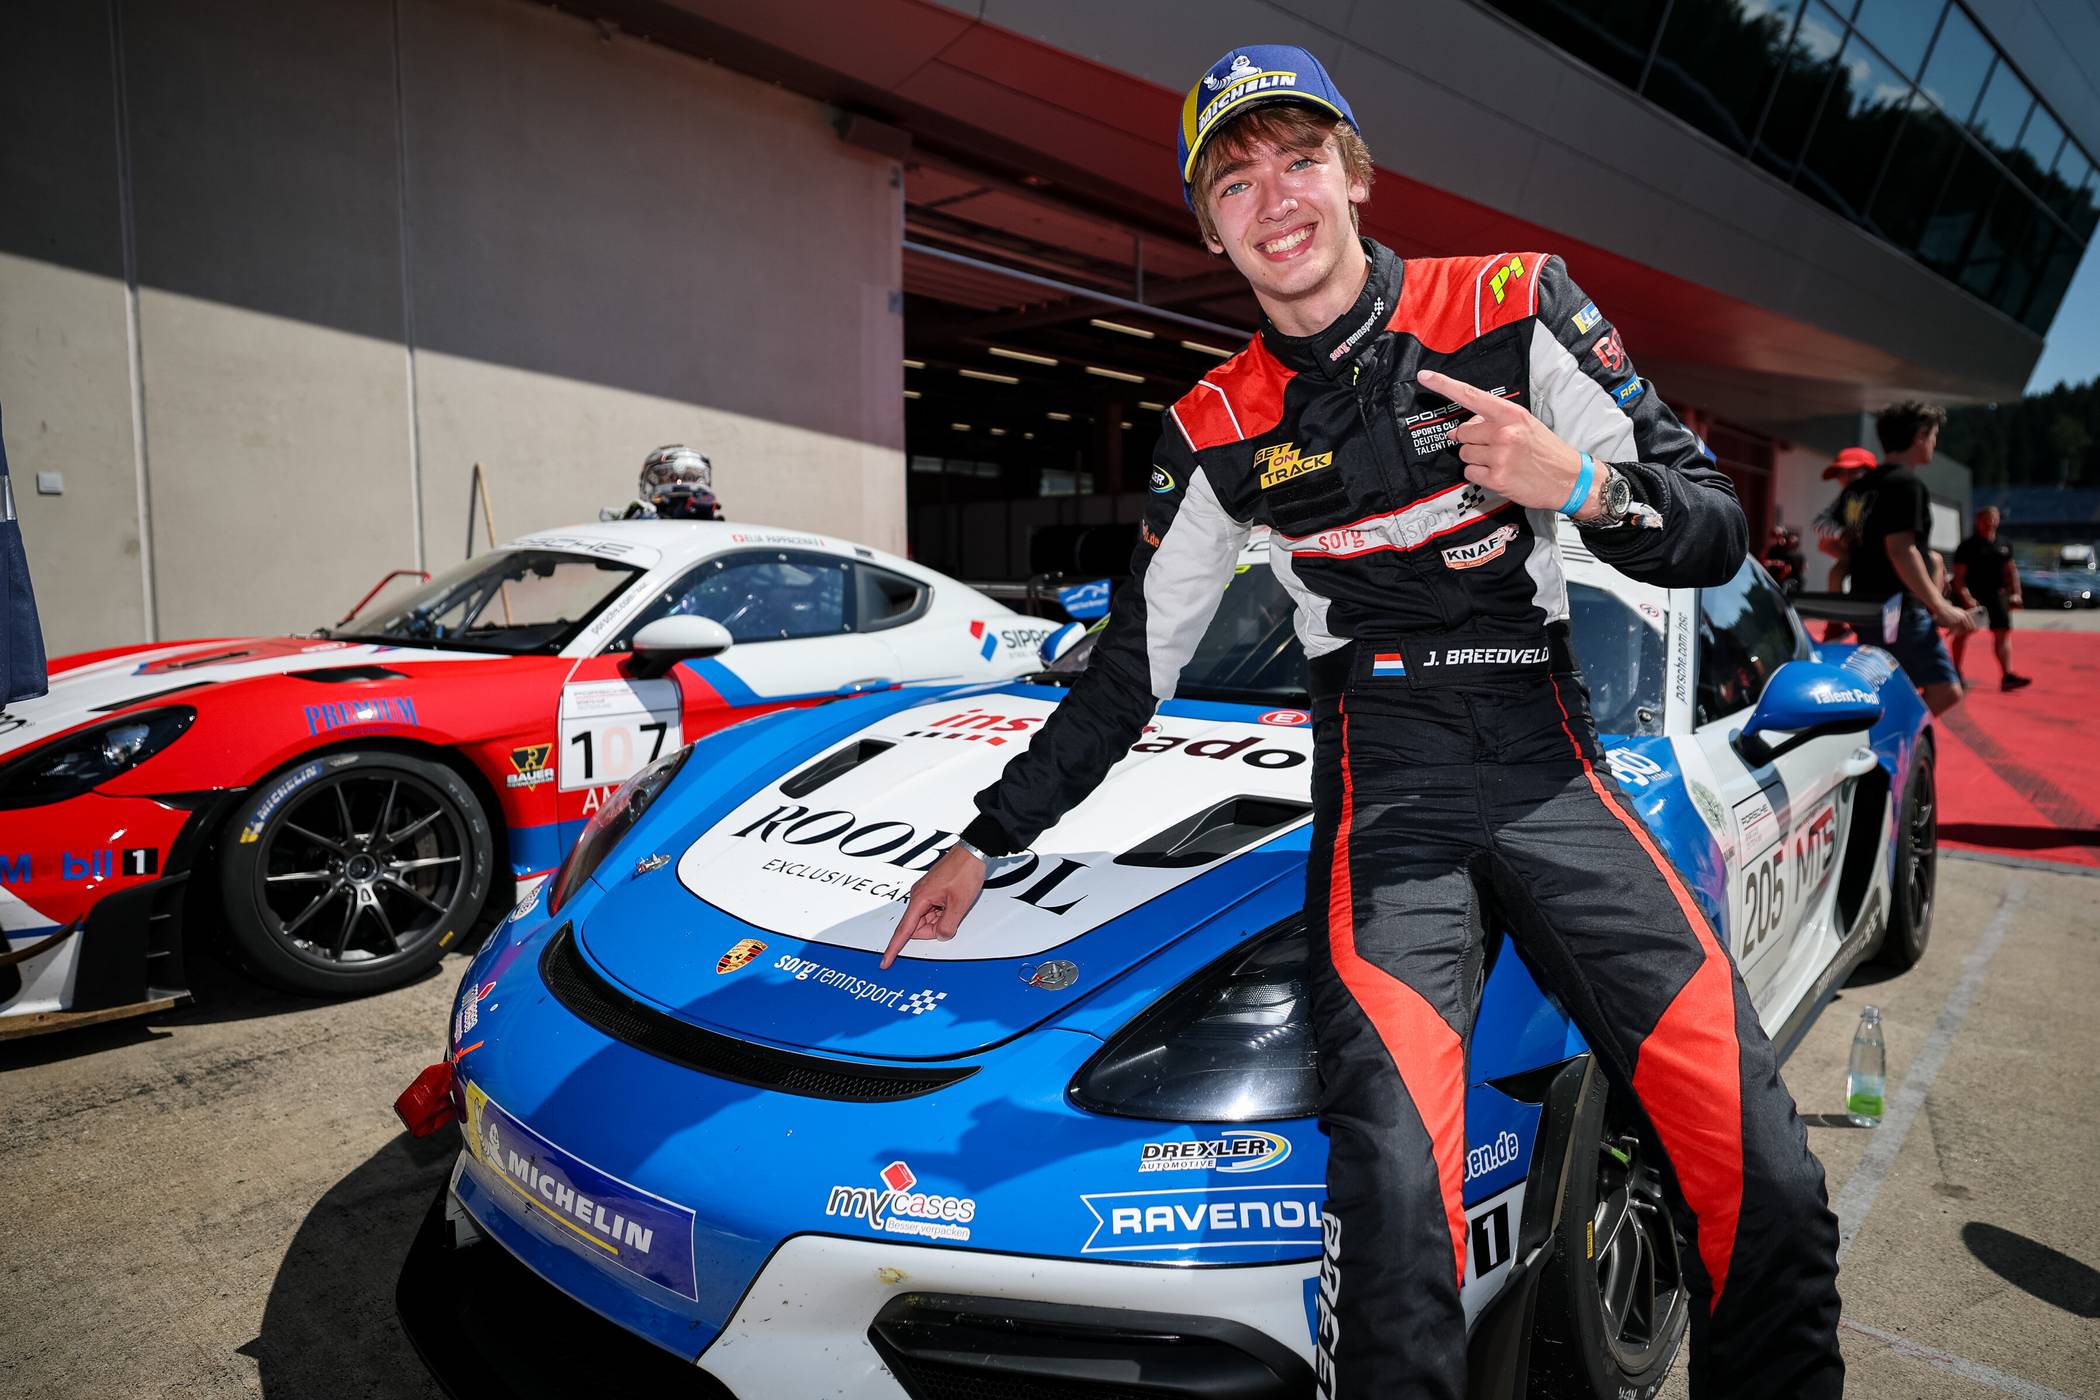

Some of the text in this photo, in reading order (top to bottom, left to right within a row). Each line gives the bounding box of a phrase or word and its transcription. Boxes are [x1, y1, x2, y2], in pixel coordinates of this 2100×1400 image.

[1199, 75, 1297, 132] MICHELIN
[1490, 255, 1526, 305] P1
[1411, 418, 1460, 439] SPORTS CUP
[1413, 432, 1449, 448] DEUTSCH
[1255, 444, 1288, 462] GET
[1273, 452, 1294, 467] ON
[1415, 442, 1446, 456] TALENT
[1264, 455, 1328, 485] TRACK
[1446, 537, 1499, 561] KNAF
[1423, 646, 1549, 667] J. BREEDVELD
[1811, 688, 1856, 705] Talent
[304, 696, 420, 737] PREMIUM
[571, 721, 668, 780] 107
[506, 768, 554, 783] BAUER
[256, 765, 318, 820] MICHELIN
[762, 859, 873, 893] EXCLUSIVE
[1742, 850, 1785, 960] 205
[1142, 1138, 1268, 1159] DREXLER
[1140, 1160, 1214, 1171] AUTOMOTIVE
[508, 1149, 654, 1254] MICHELIN
[1112, 1200, 1322, 1235] RAVENOL
